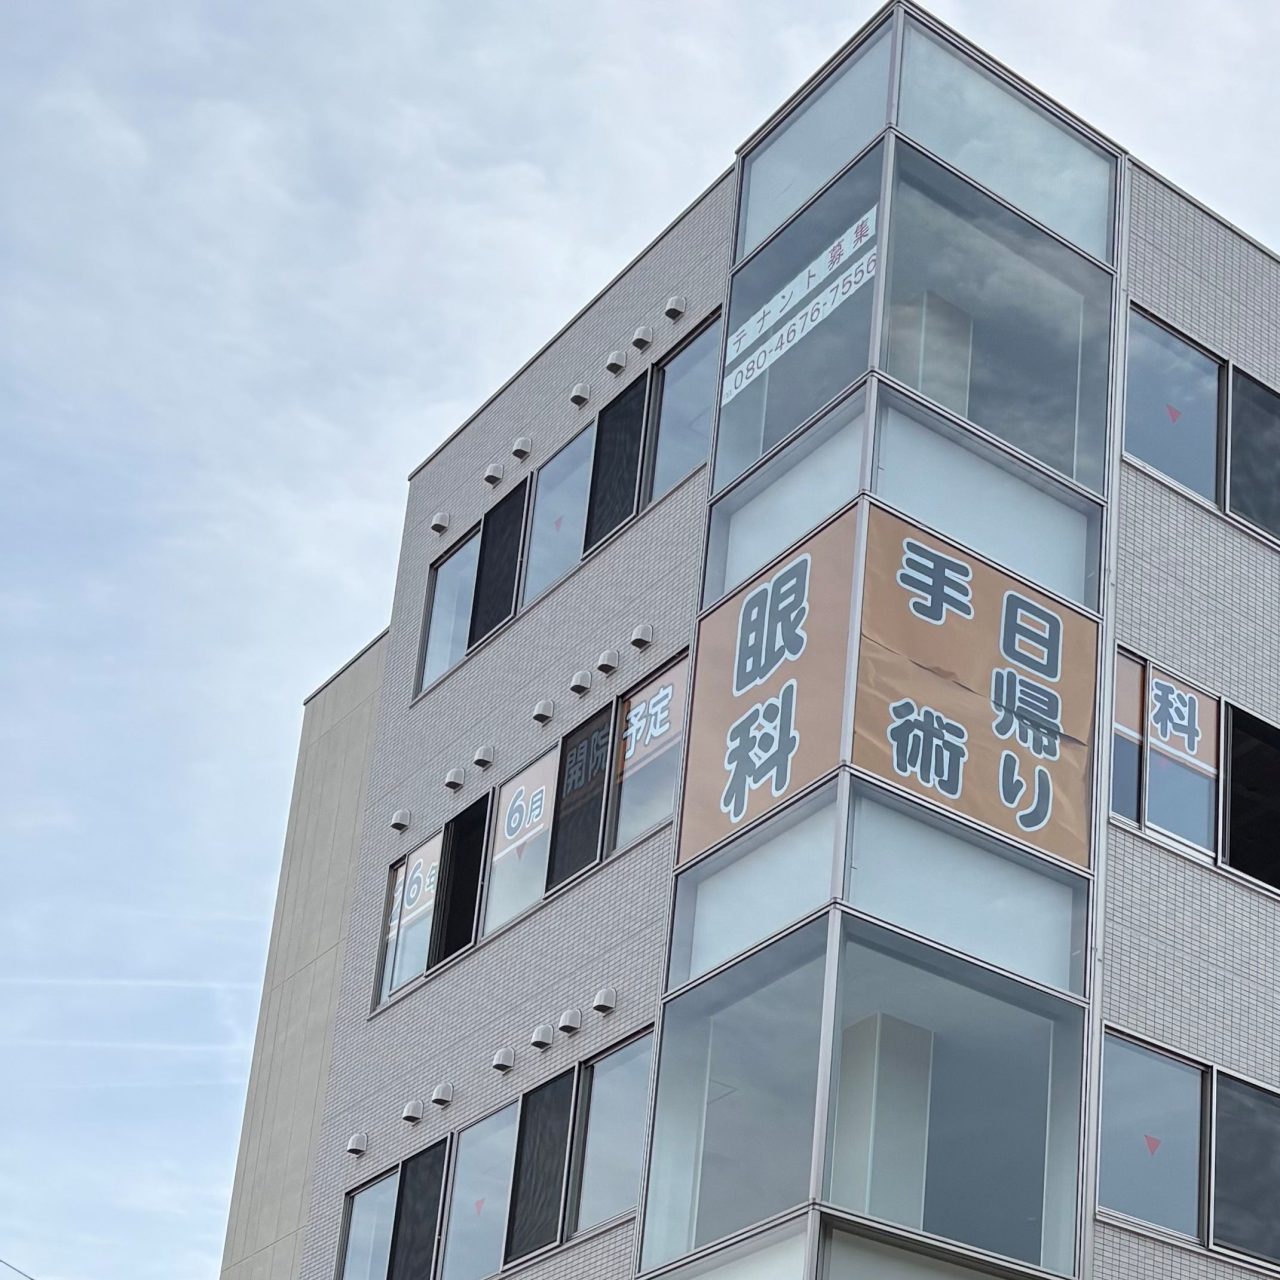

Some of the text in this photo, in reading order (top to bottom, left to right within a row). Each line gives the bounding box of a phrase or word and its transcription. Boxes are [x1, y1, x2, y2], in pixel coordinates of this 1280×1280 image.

[732, 217, 870, 353] テナント募集
[734, 252, 877, 390] 080-4676-7556
[721, 552, 811, 823] 眼科
[887, 537, 974, 800] 手術
[991, 590, 1064, 833] 日帰り
[1151, 678, 1201, 754] 科
